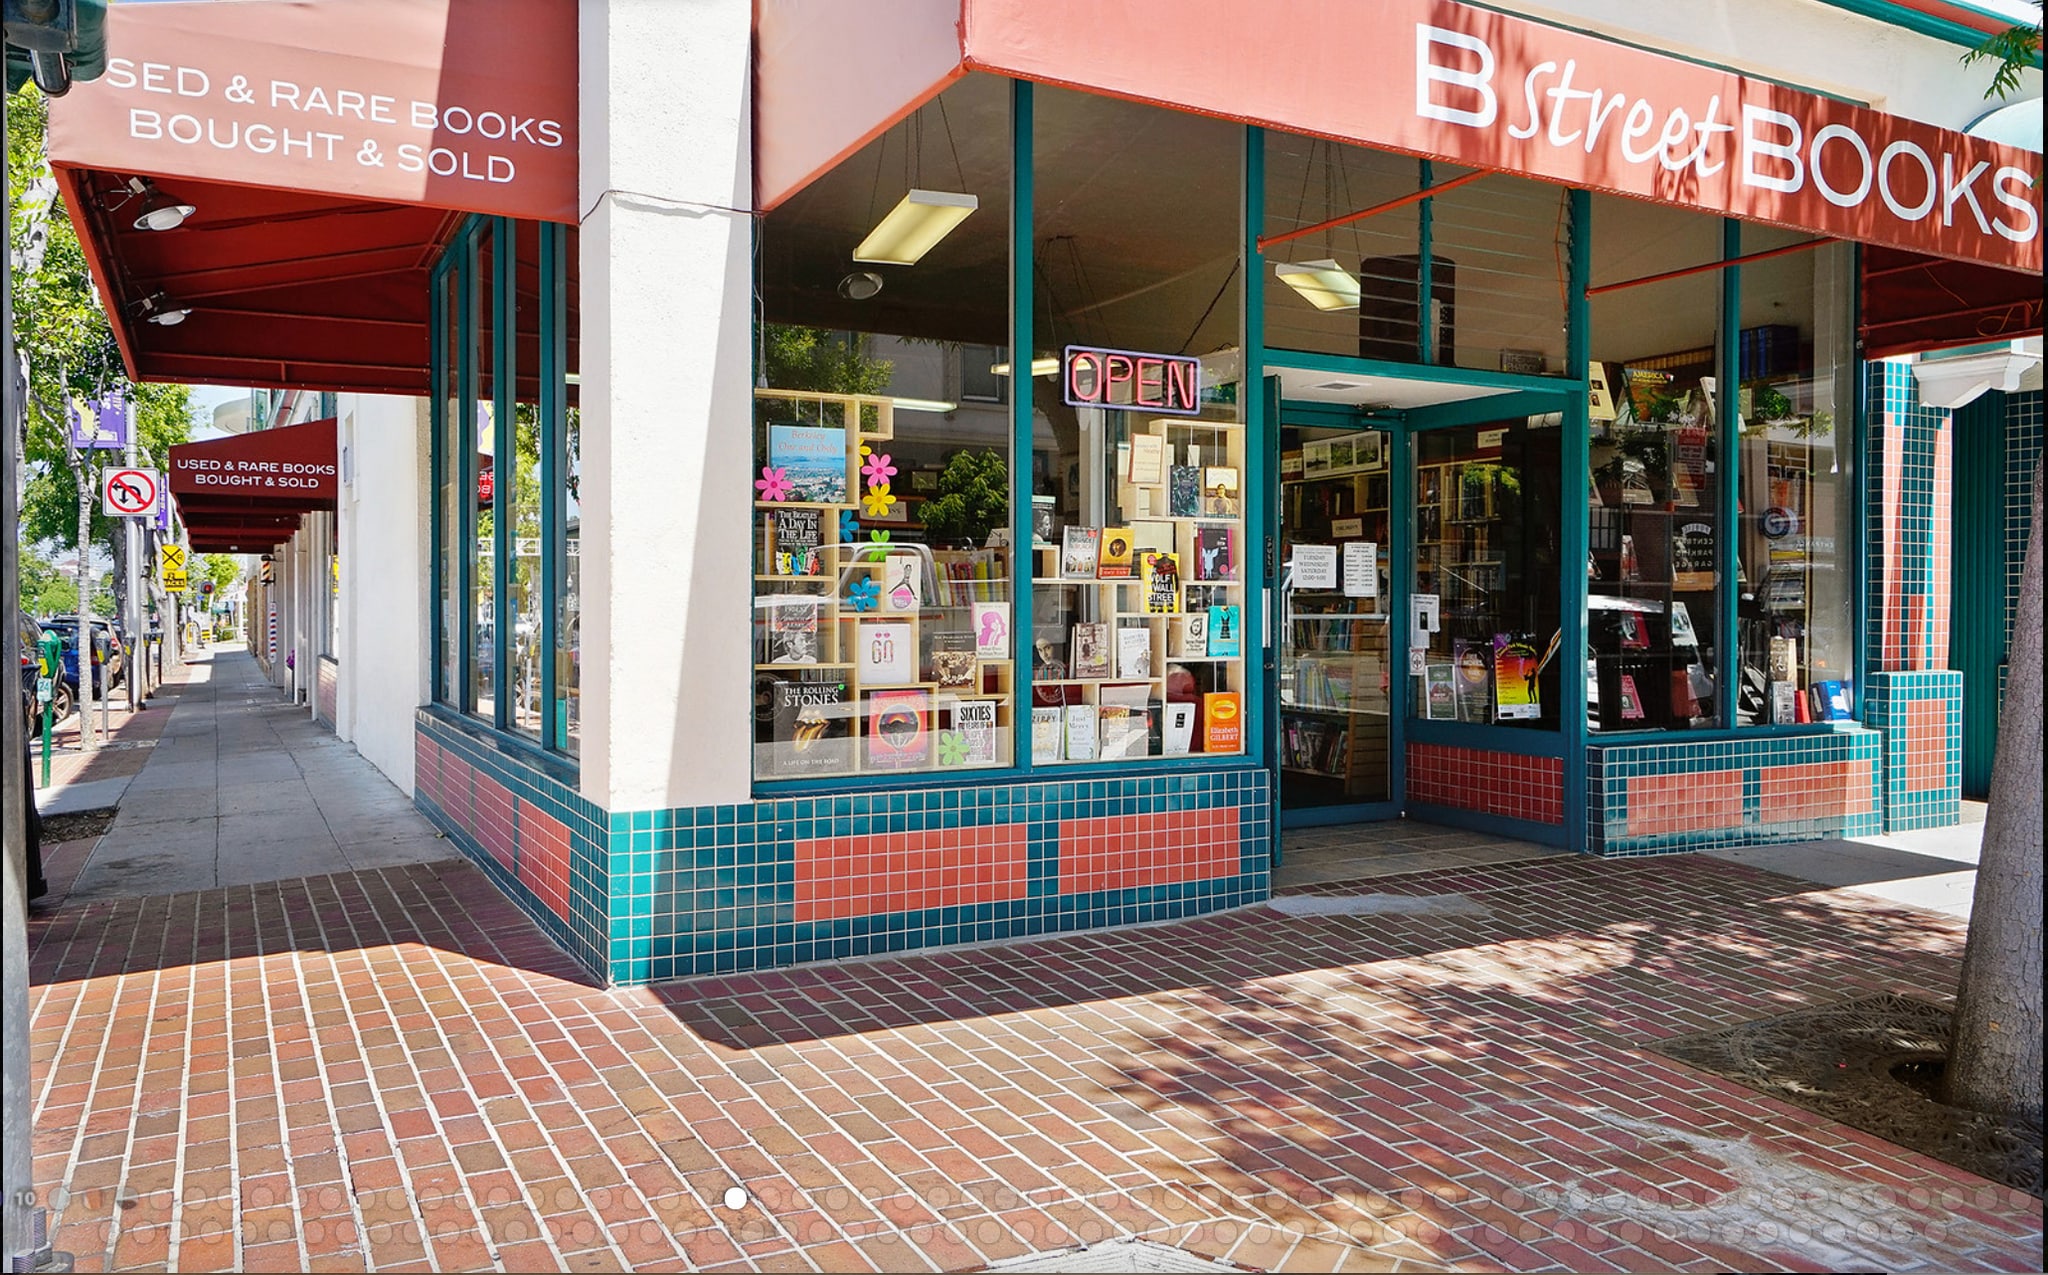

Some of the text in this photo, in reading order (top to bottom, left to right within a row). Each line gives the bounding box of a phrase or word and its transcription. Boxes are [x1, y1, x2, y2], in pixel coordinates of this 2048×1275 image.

[106, 57, 563, 148] SED & RARE BOOKS
[1415, 22, 2040, 245] B street BOOKS
[129, 107, 515, 183] BOUGHT & SOLD
[1071, 352, 1194, 409] OPEN
[1632, 370, 1664, 379] AMERICA
[177, 459, 336, 475] USED & RARE BOOKS
[195, 474, 319, 488] BOUGHT & SOLD
[778, 518, 787, 529] A
[778, 529, 818, 540] THE LIFE
[38, 682, 49, 692] 24
[784, 686, 838, 696] THE ROLLING
[784, 694, 839, 707] STONES
[1210, 733, 1239, 742] GILBERT
